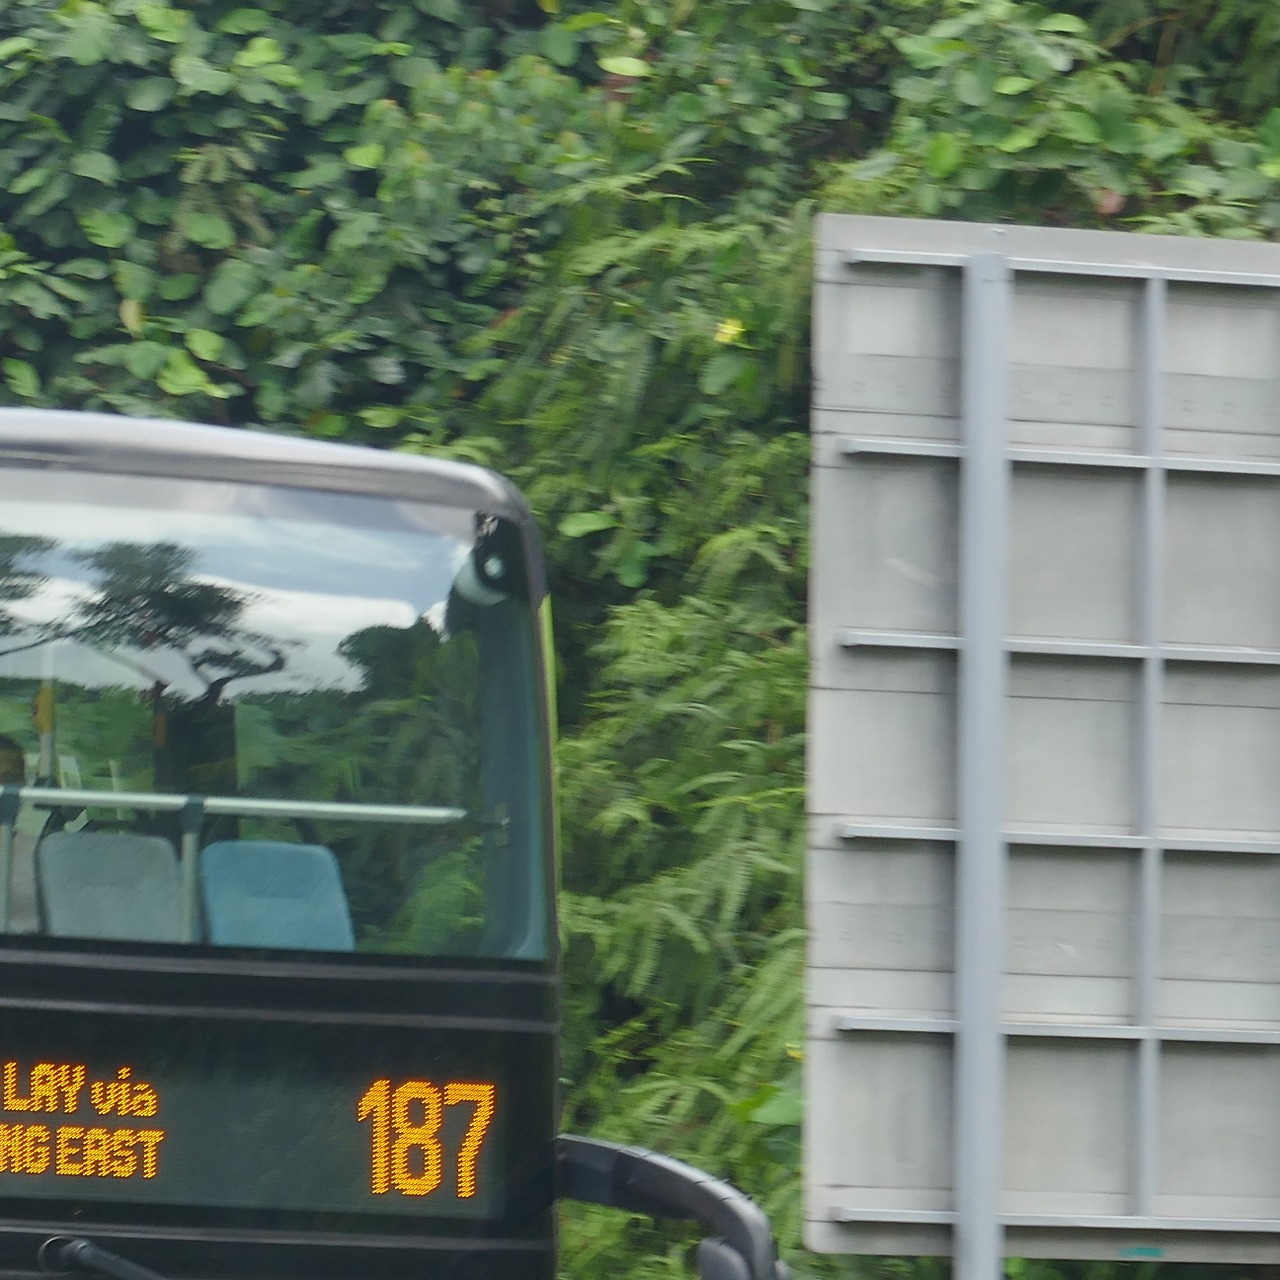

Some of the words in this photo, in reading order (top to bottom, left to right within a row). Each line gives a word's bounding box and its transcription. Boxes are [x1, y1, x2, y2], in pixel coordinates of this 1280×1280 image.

[3, 1062, 86, 1113] LAY
[91, 1066, 158, 1116] via
[56, 1126, 164, 1179] EAST
[358, 1079, 495, 1198] 187
